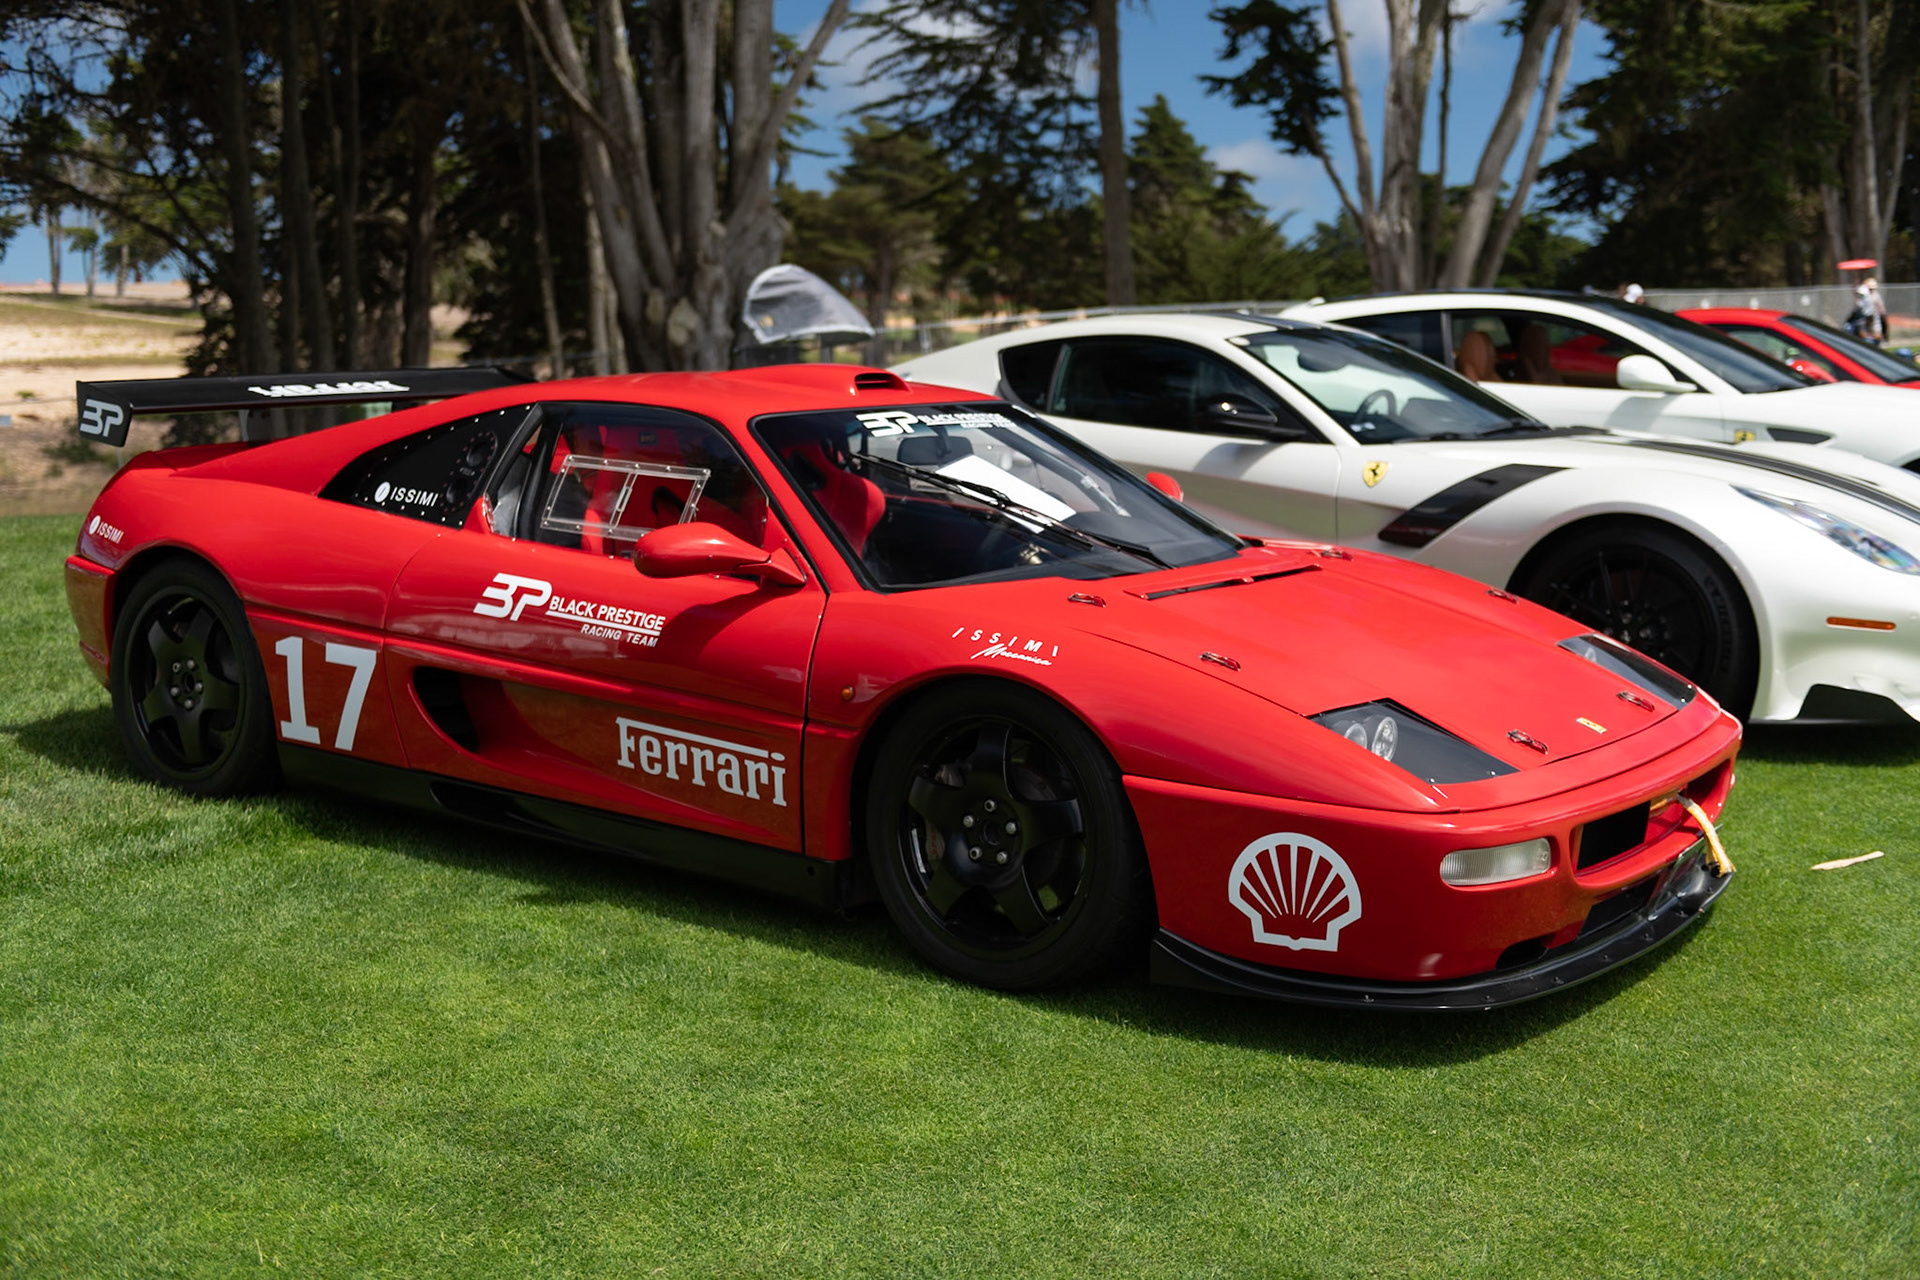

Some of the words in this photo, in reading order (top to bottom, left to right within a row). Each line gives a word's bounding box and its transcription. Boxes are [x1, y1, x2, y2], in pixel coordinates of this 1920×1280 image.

[390, 486, 439, 507] ISSIMI
[97, 521, 124, 544] ISSIMI
[549, 595, 598, 618] BLACK
[596, 605, 666, 631] PRESTIGE
[580, 623, 622, 641] RACING
[626, 632, 659, 648] TEAM
[952, 627, 1059, 657] ISSIMI
[275, 635, 377, 751] 17
[615, 716, 787, 807] Ferrari
